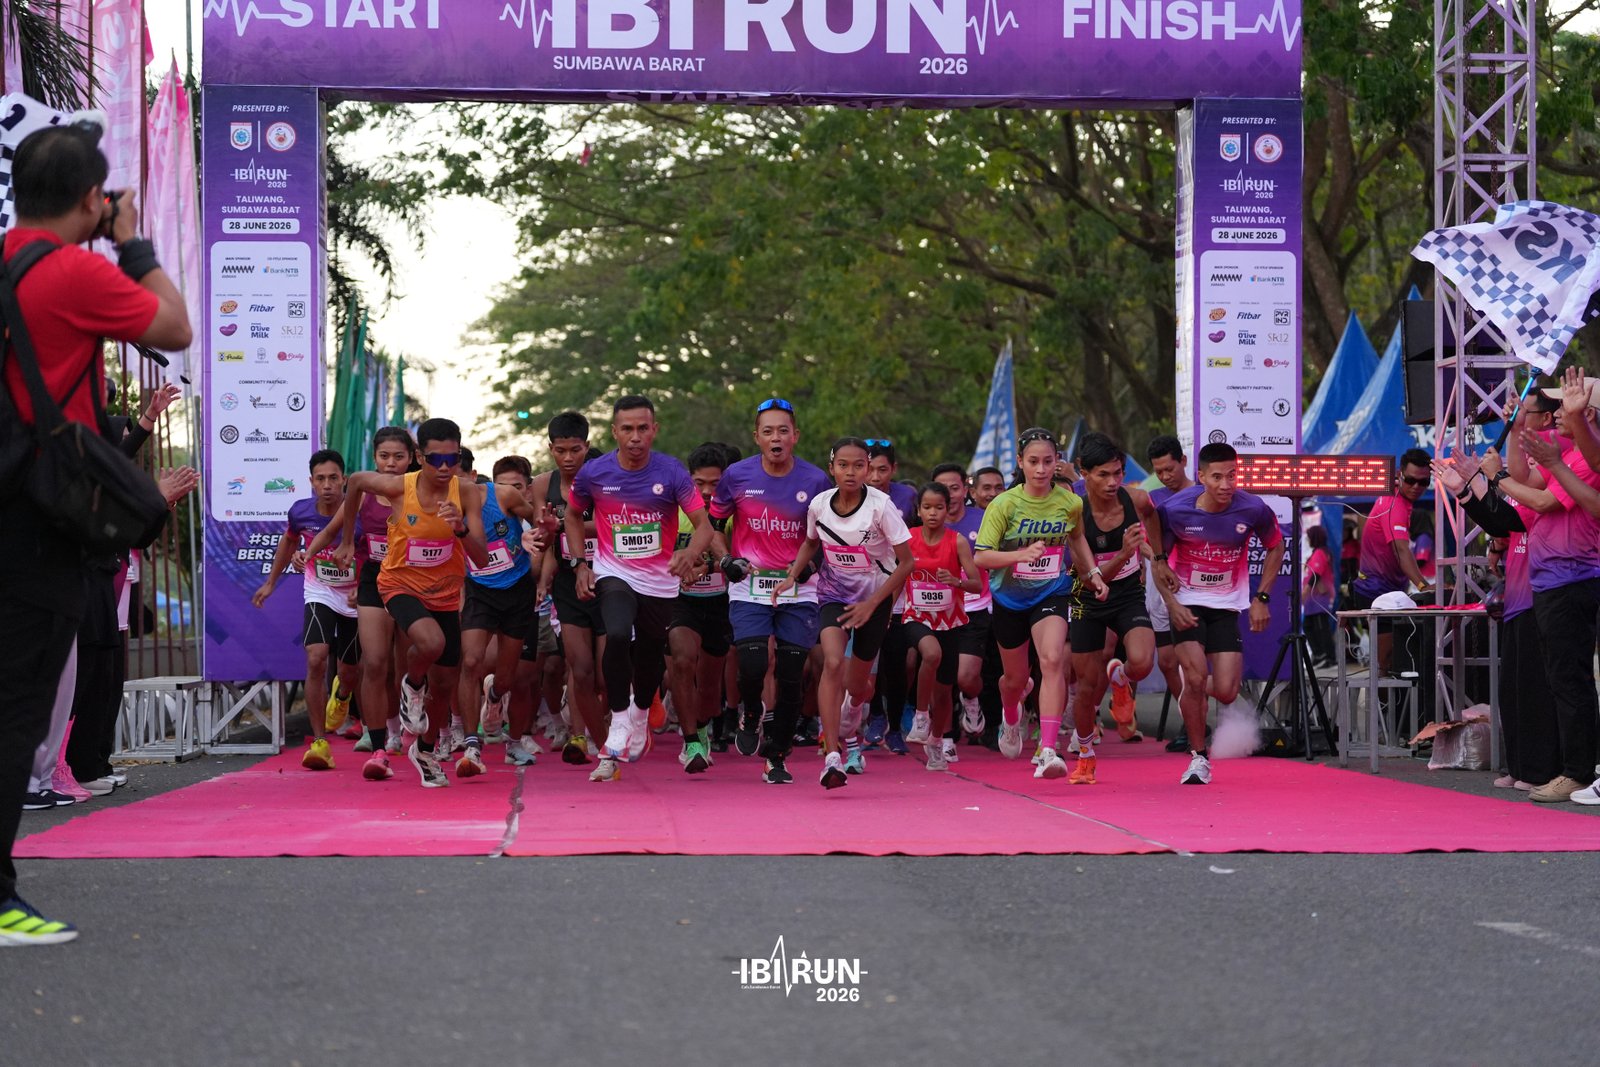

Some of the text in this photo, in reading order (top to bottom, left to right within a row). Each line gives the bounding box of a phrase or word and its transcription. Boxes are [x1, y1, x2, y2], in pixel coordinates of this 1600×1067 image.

[279, 0, 439, 28] START
[1063, 0, 1236, 40] FINISH
[553, 55, 706, 72] SUMBAWA BARAT
[919, 57, 968, 75] 2026
[277, 105, 289, 113] BY:
[1222, 117, 1263, 125] PRESENTED
[235, 168, 287, 180] IBI RUN
[1224, 180, 1274, 191] IBI RUN
[236, 195, 286, 204] TALIWANG,
[221, 206, 300, 214] SUMBAWA BARAT
[1225, 205, 1272, 214] TALIWANG,
[1211, 216, 1286, 224] SUMBAWA BARAT
[229, 221, 292, 230] 28 JUNE 2026
[1218, 231, 1229, 239] 28
[249, 304, 275, 312] Fitbar
[1237, 312, 1262, 320] Fitbar
[770, 518, 801, 532] RUN
[621, 534, 653, 546] 5M013
[422, 548, 443, 557] 5177
[835, 553, 856, 563] 5170
[321, 567, 349, 578] 5M009
[1200, 573, 1224, 582] 5066
[921, 591, 944, 601] 5036
